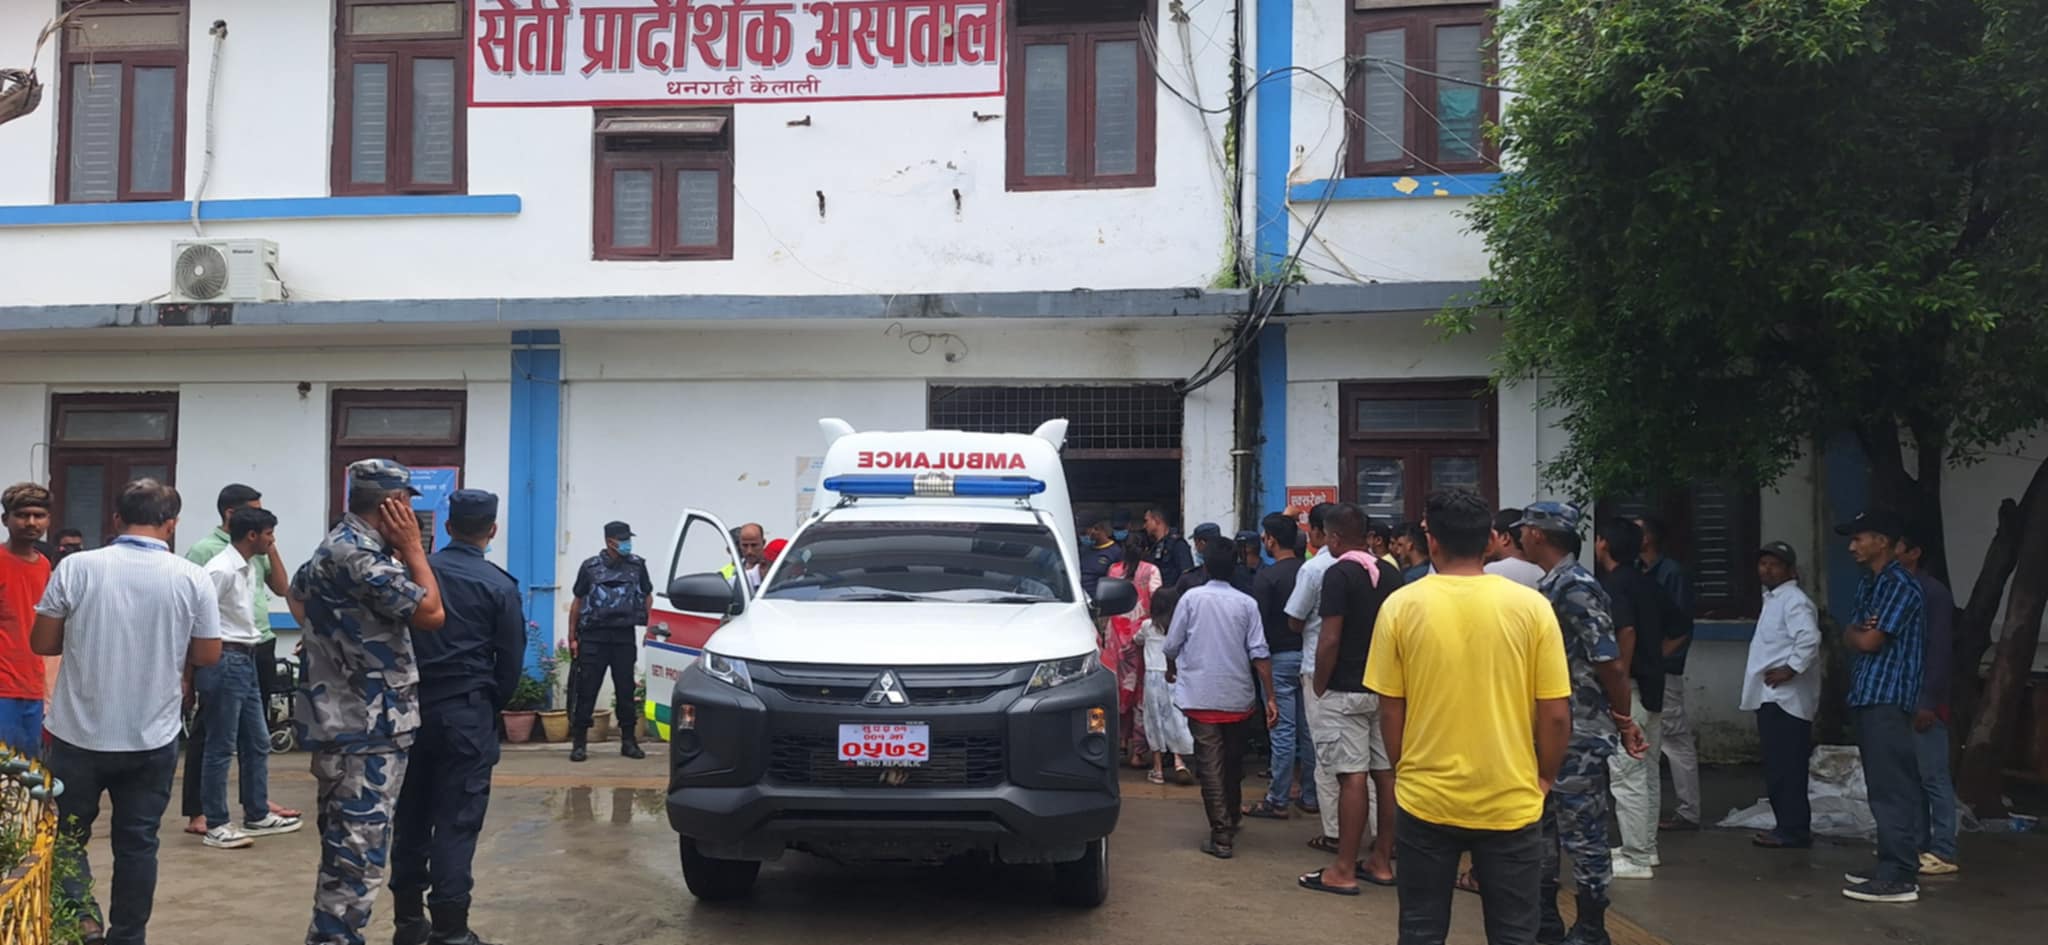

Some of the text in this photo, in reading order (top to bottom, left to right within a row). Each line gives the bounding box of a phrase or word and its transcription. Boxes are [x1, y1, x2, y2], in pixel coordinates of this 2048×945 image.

[803, 0, 999, 68] अस्पताल
[750, 74, 821, 96] कैलाली
[842, 742, 926, 758] ०५७२
[856, 759, 920, 767] MITSU REPUBLIC
